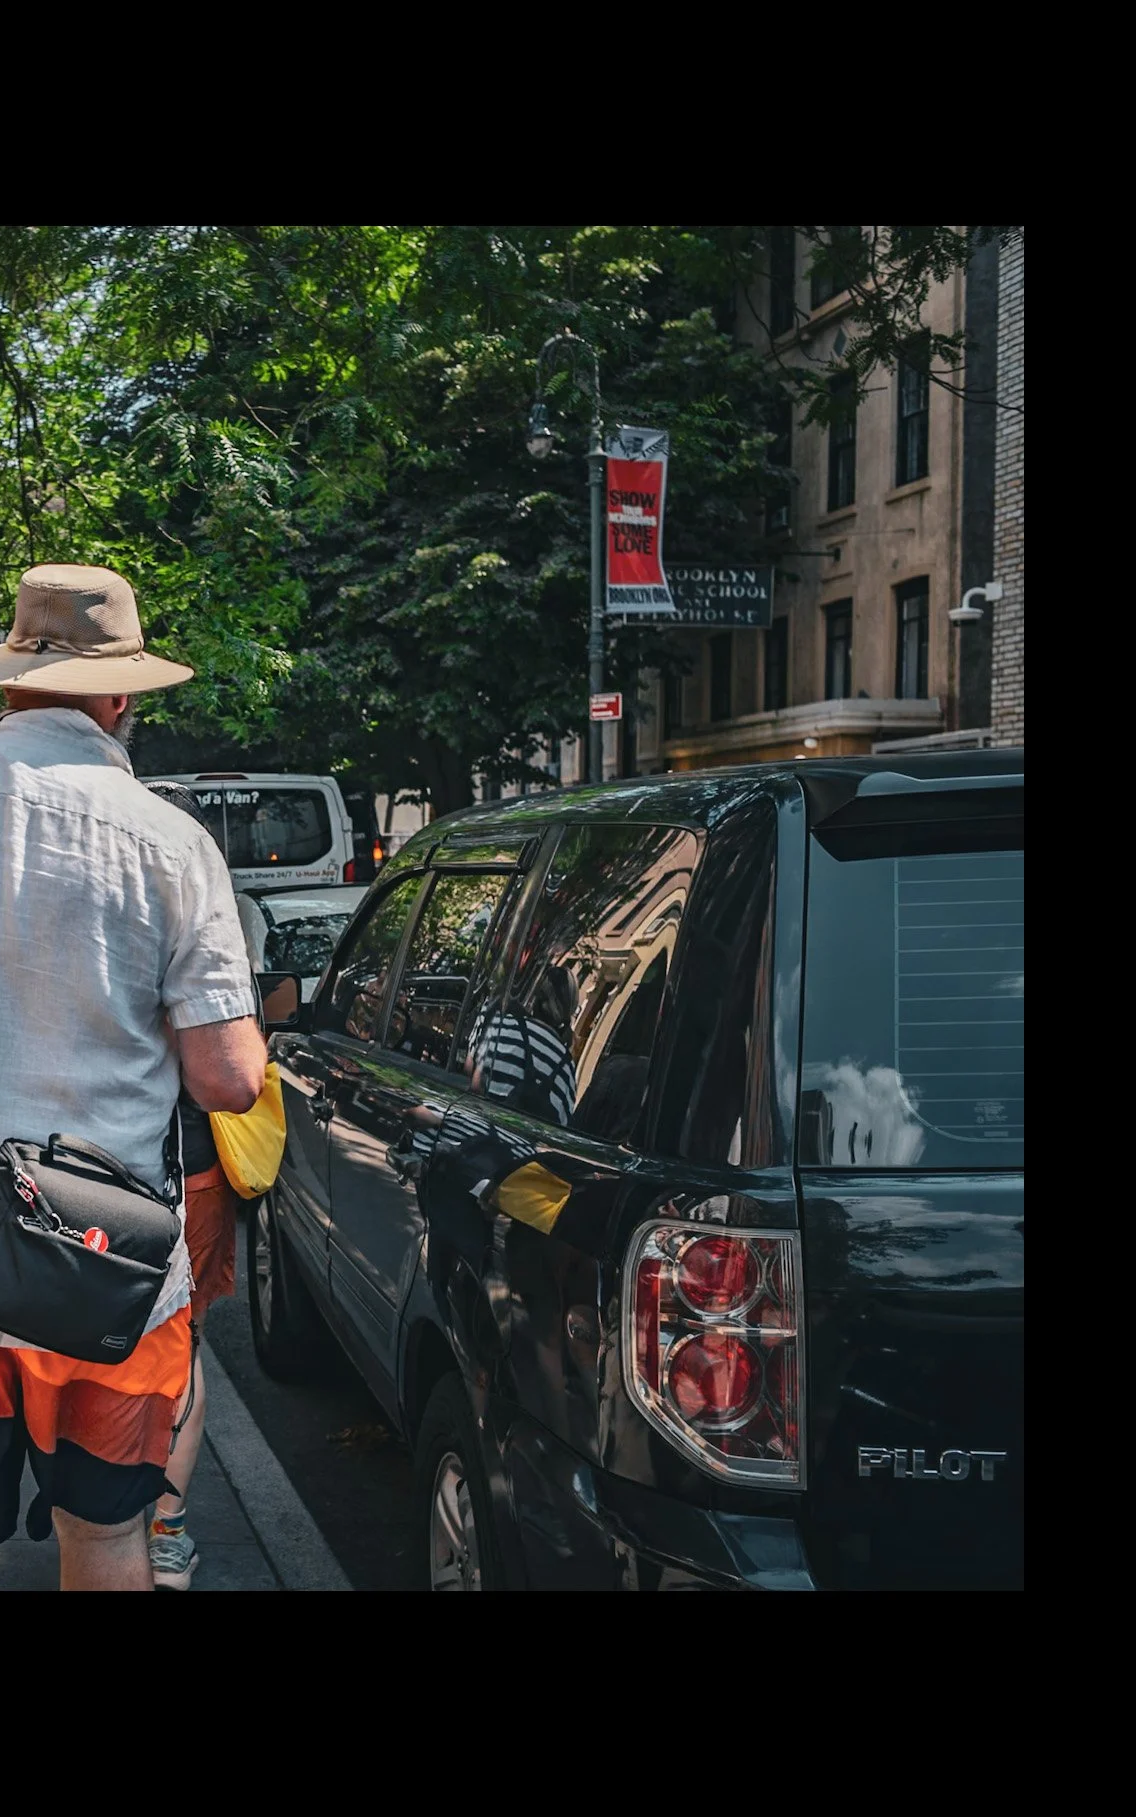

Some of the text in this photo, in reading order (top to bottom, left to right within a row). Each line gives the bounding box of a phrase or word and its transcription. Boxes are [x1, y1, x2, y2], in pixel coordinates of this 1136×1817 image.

[609, 490, 655, 508] SHOW
[613, 524, 652, 540] SOME
[615, 538, 652, 554] LOVE
[665, 569, 755, 583] ROOKLYN
[695, 586, 767, 599] SCHOOL
[213, 794, 222, 804] a
[226, 791, 260, 804] Van?
[276, 871, 293, 879] 24/7
[858, 1447, 1007, 1481] PILOT
